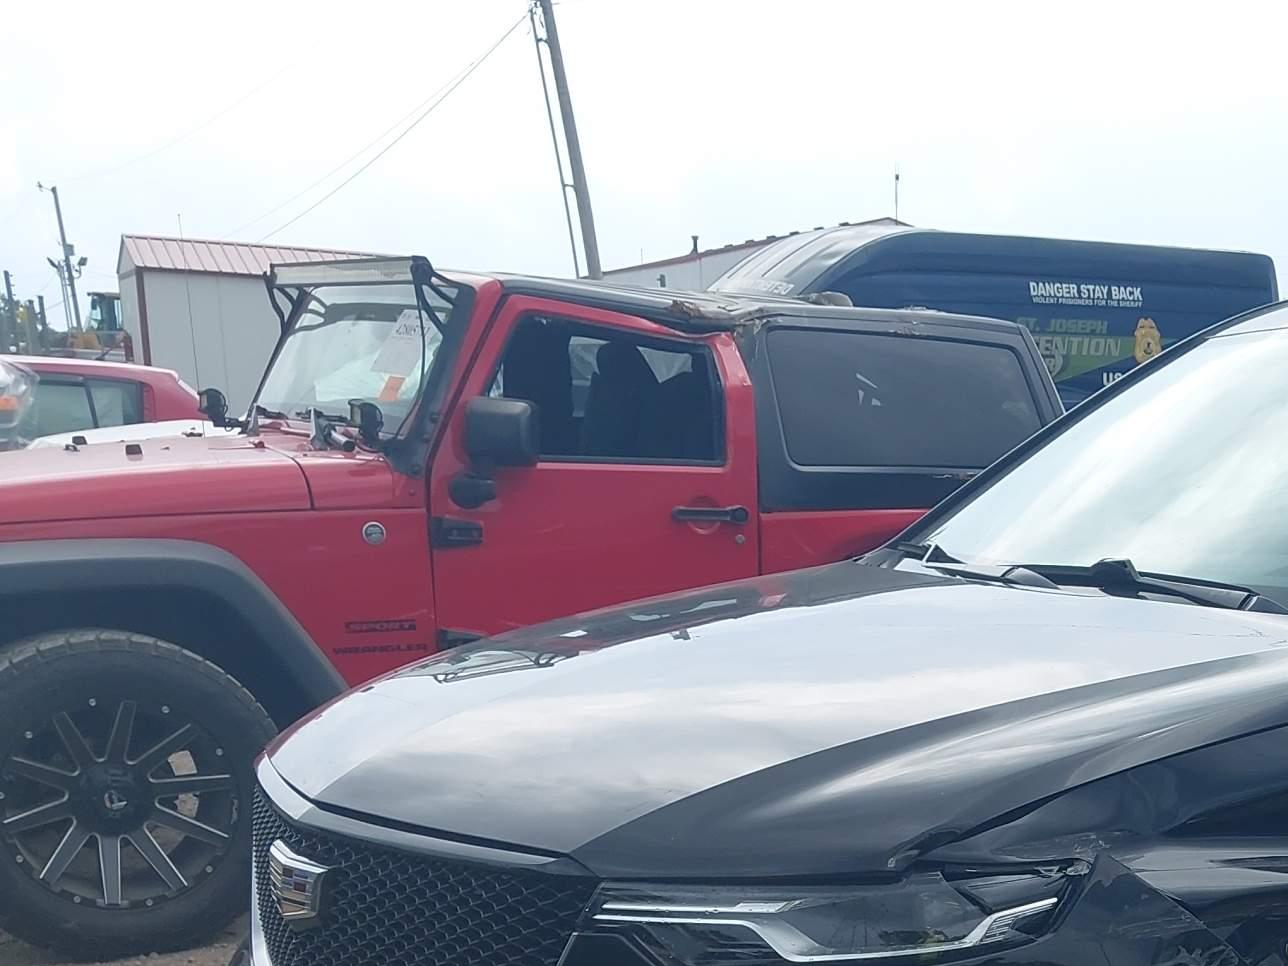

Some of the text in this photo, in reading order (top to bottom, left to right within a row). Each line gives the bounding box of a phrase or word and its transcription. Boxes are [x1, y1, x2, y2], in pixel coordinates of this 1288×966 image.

[1029, 281, 1143, 301] DANGER STAY BACK
[1032, 296, 1057, 304] VIOLENT
[1046, 318, 1108, 334] JOSEPH
[348, 620, 412, 632] SPORT
[333, 643, 428, 655] WRANGLER
